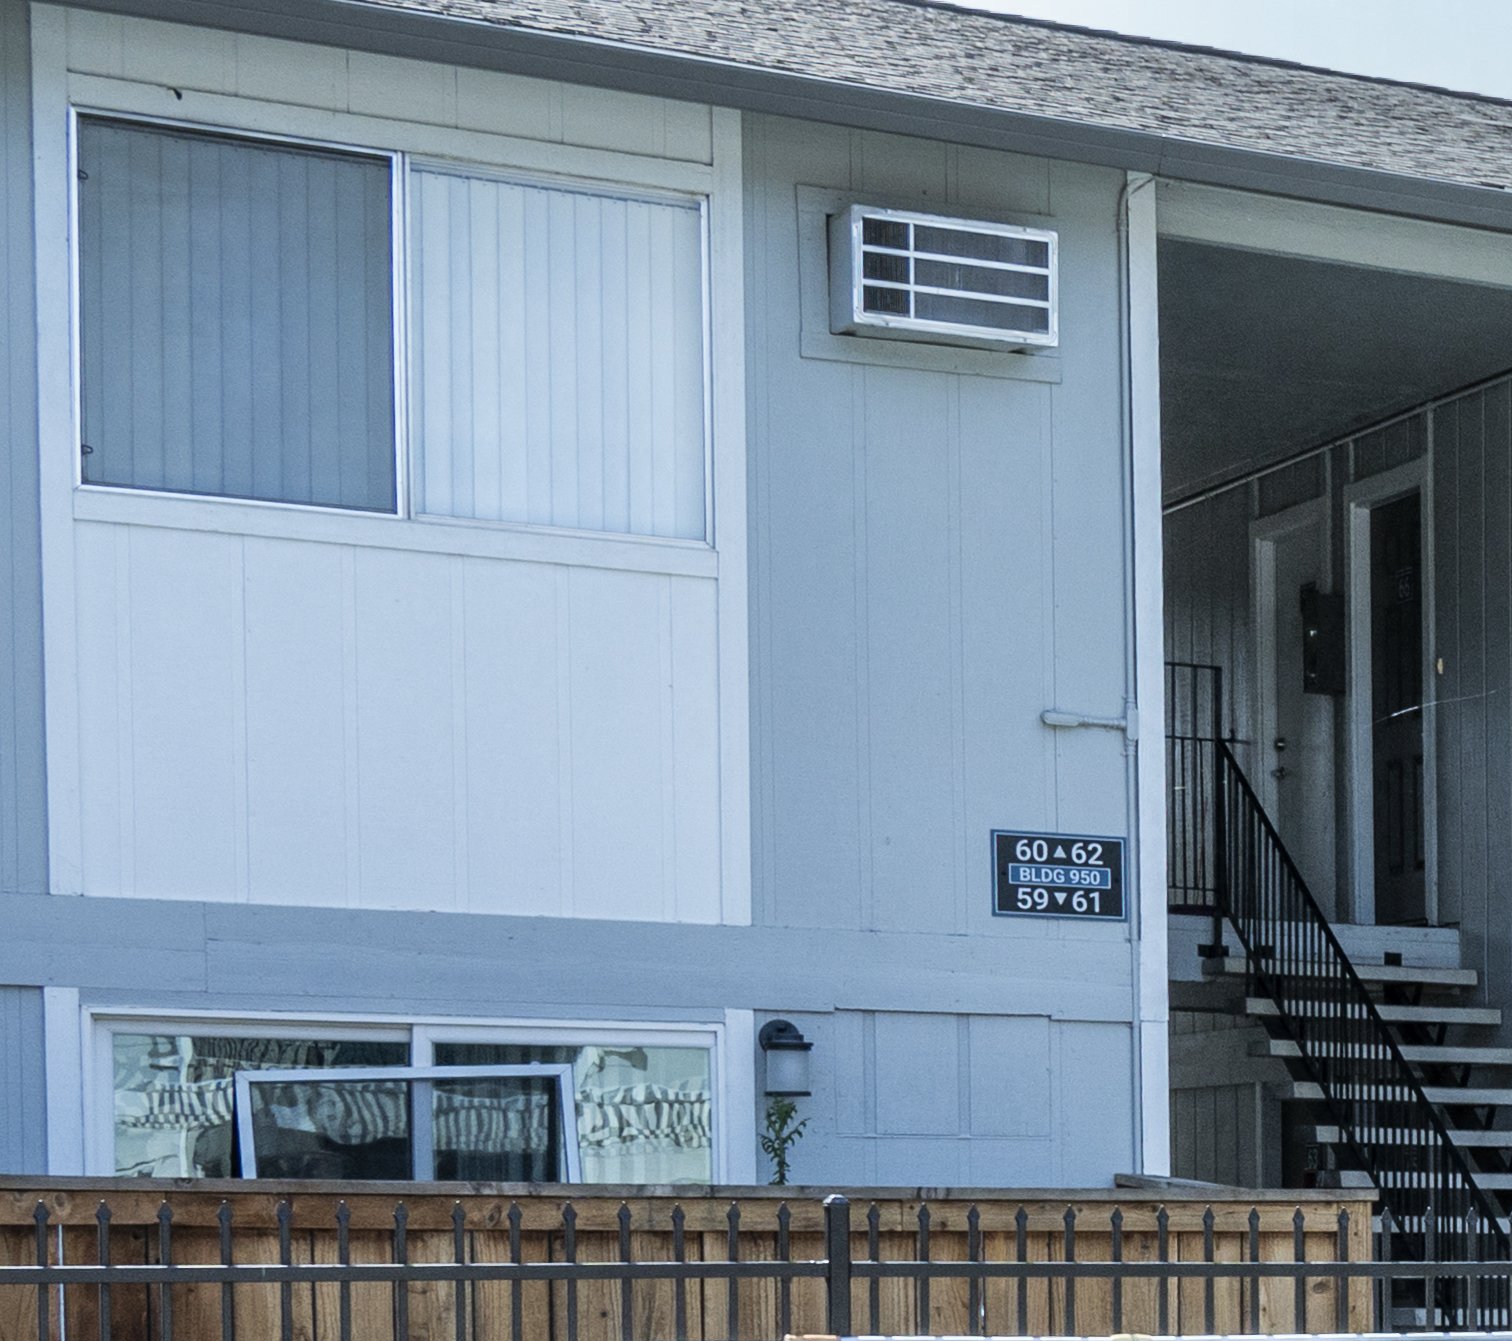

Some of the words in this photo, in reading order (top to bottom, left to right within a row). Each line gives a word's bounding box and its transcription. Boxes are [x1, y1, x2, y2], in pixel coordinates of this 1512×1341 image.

[1016, 839, 1048, 861] 60
[1071, 843, 1104, 865] 62
[1019, 867, 1065, 883] BLDG
[1069, 870, 1100, 885] 950
[1017, 887, 1049, 910] 59
[1072, 891, 1100, 913] 61
